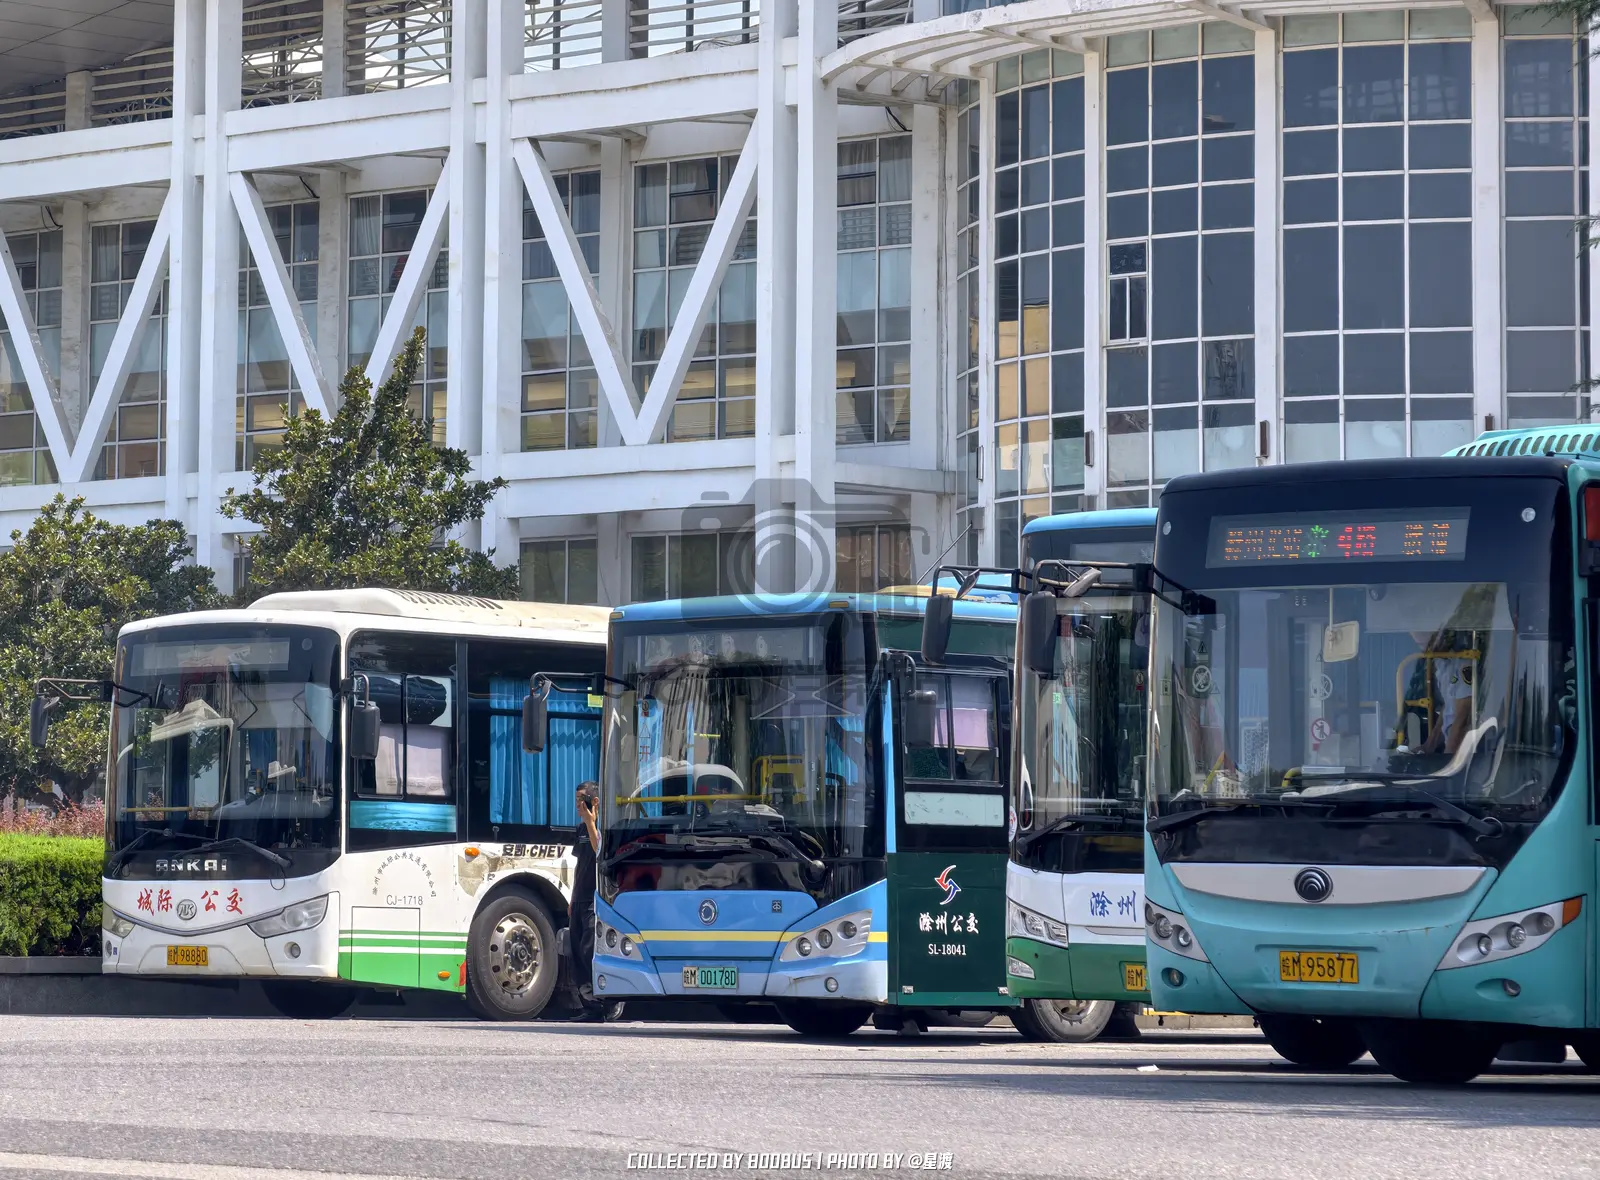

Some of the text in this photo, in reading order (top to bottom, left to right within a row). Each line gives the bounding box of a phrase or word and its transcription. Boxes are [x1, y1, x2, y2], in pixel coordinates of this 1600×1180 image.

[386, 894, 424, 906] CJ-1718
[1089, 890, 1137, 922] 滁州
[919, 911, 979, 935] 滁州公交
[928, 943, 967, 956] SL-18041
